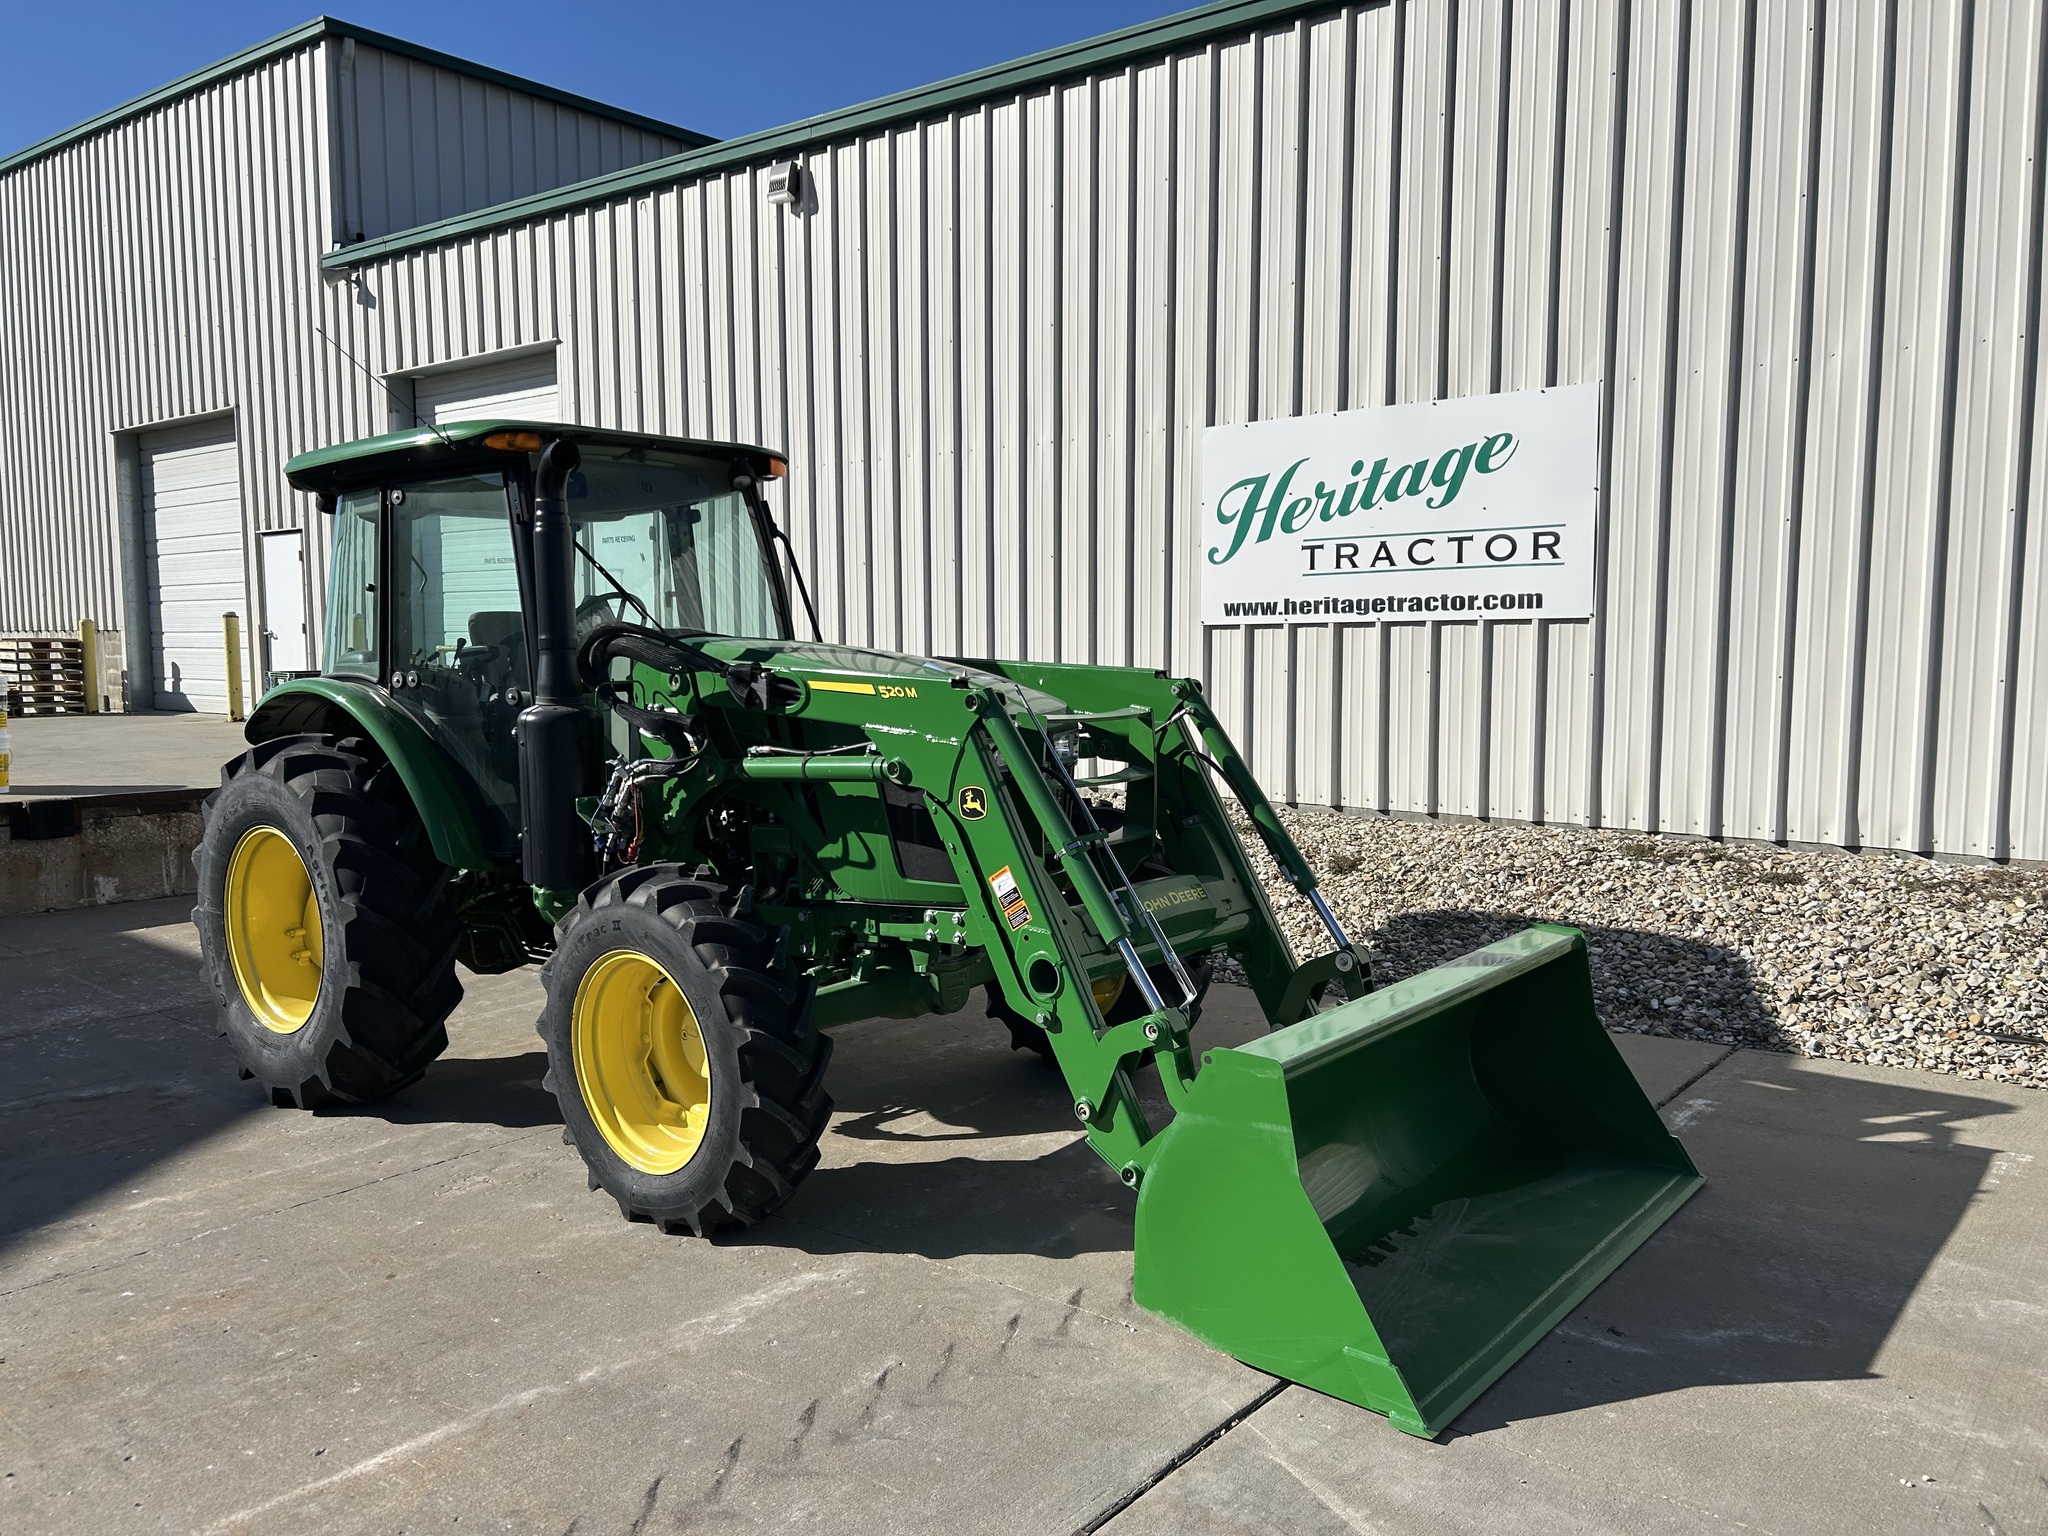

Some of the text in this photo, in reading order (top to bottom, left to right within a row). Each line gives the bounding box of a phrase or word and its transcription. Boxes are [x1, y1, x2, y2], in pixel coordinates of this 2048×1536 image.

[1207, 432, 1520, 566] Heritage
[602, 536, 614, 544] PARTS
[1301, 530, 1562, 571] TRACTOR
[1223, 592, 1544, 618] www.heritagetractor.com
[878, 685, 918, 699] 520 M
[1143, 887, 1207, 912] OHN DEERE
